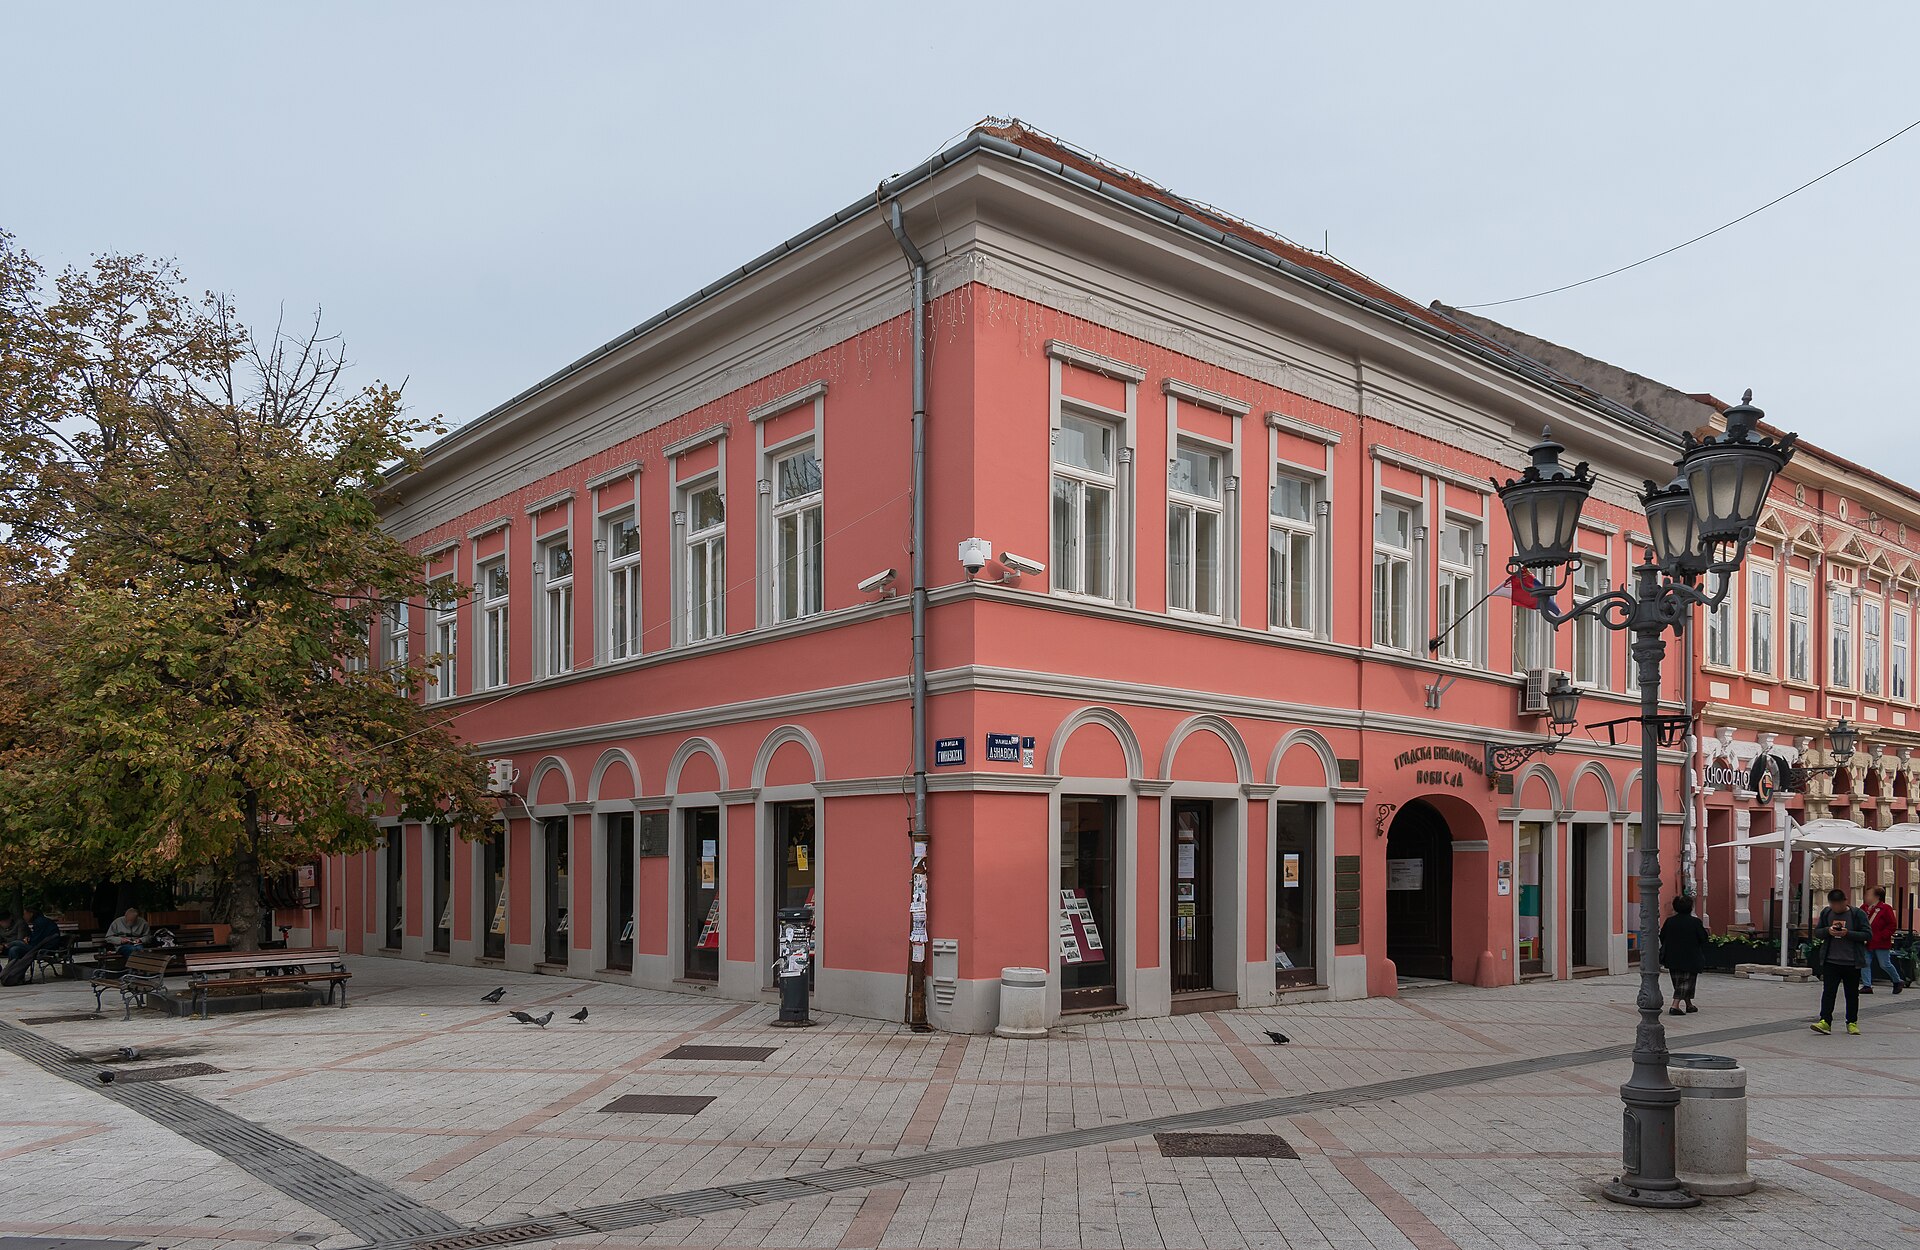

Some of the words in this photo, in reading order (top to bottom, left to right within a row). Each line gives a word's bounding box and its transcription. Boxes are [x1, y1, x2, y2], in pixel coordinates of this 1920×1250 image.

[940, 740, 959, 748] УЛИЦА
[989, 746, 1018, 759] ДУНАВСКА
[1394, 746, 1432, 770] ГРАДСКА
[1433, 746, 1483, 775] БИБЛИОТЕКА
[1416, 770, 1442, 785] НОВИ
[1706, 766, 1750, 786] CHOCOLATO
